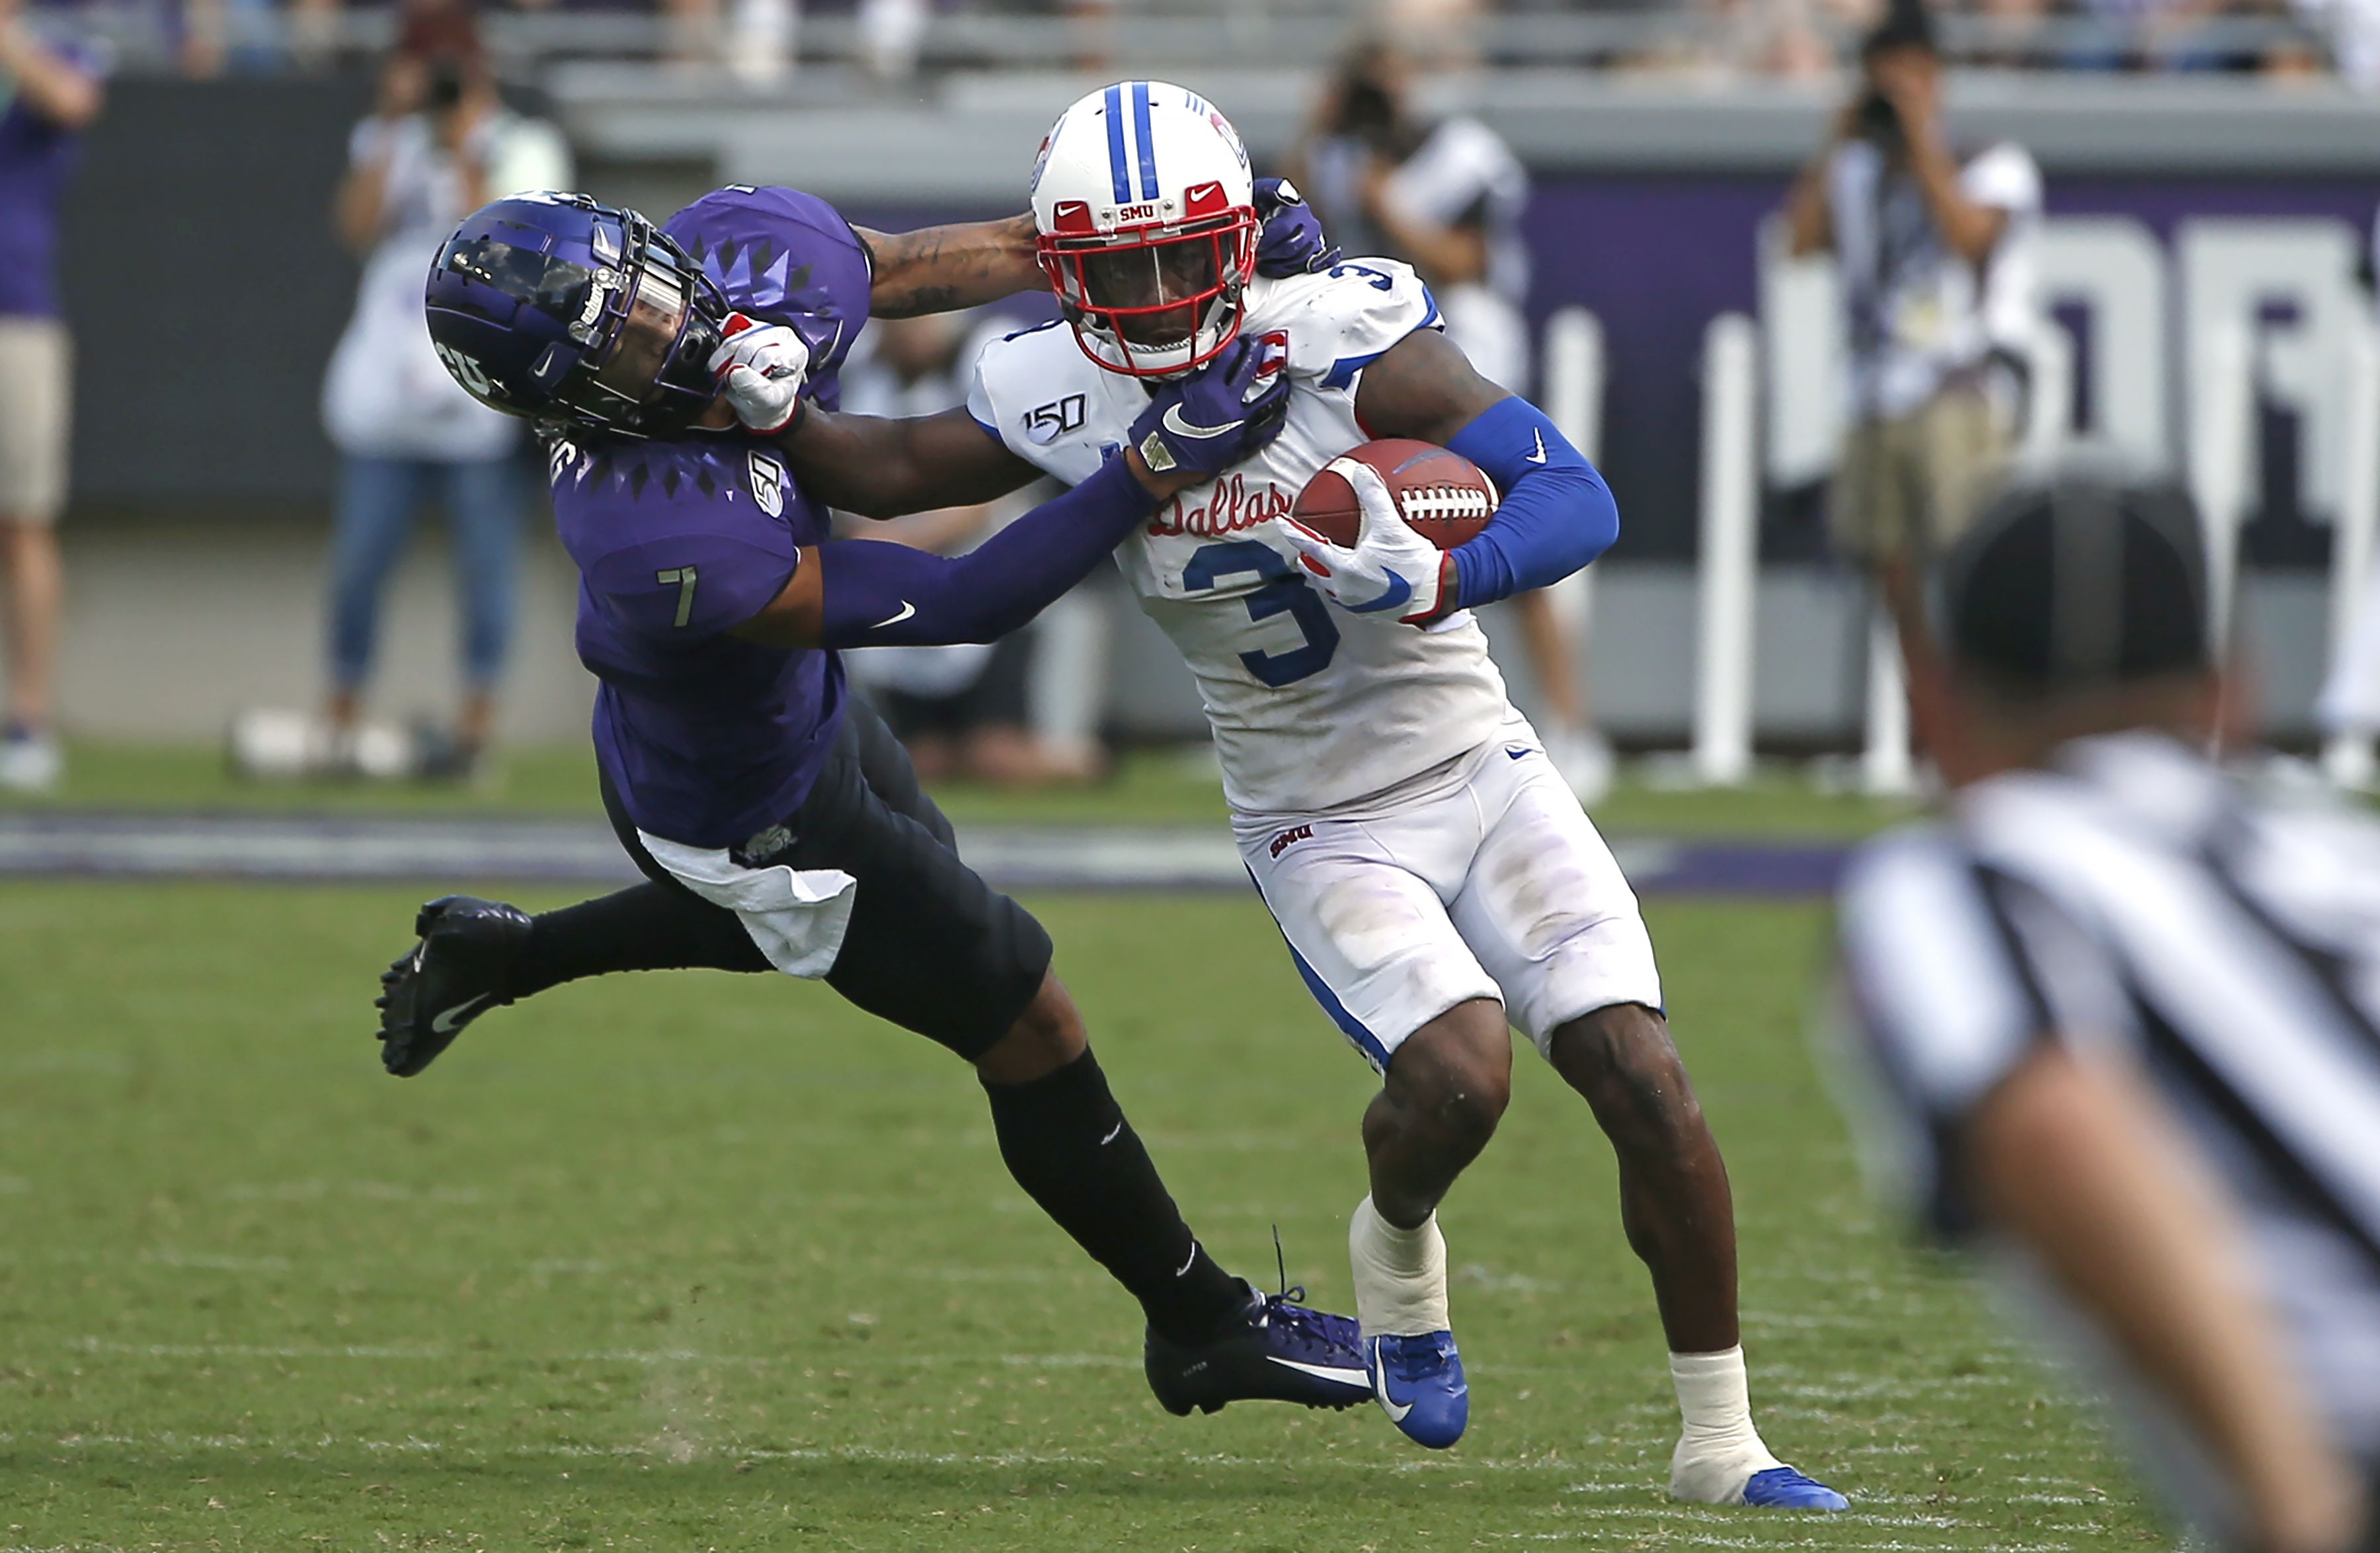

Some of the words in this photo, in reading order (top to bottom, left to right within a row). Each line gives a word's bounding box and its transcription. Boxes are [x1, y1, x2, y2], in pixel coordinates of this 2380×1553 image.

[1120, 205, 1154, 221] SMU
[1328, 264, 1392, 292] 3
[435, 341, 491, 396] CU
[1023, 393, 1087, 445] 150
[1148, 472, 1293, 537] Dallas
[656, 565, 697, 627] 7
[1182, 539, 1341, 688] 3
[1269, 824, 1314, 859] SMU
